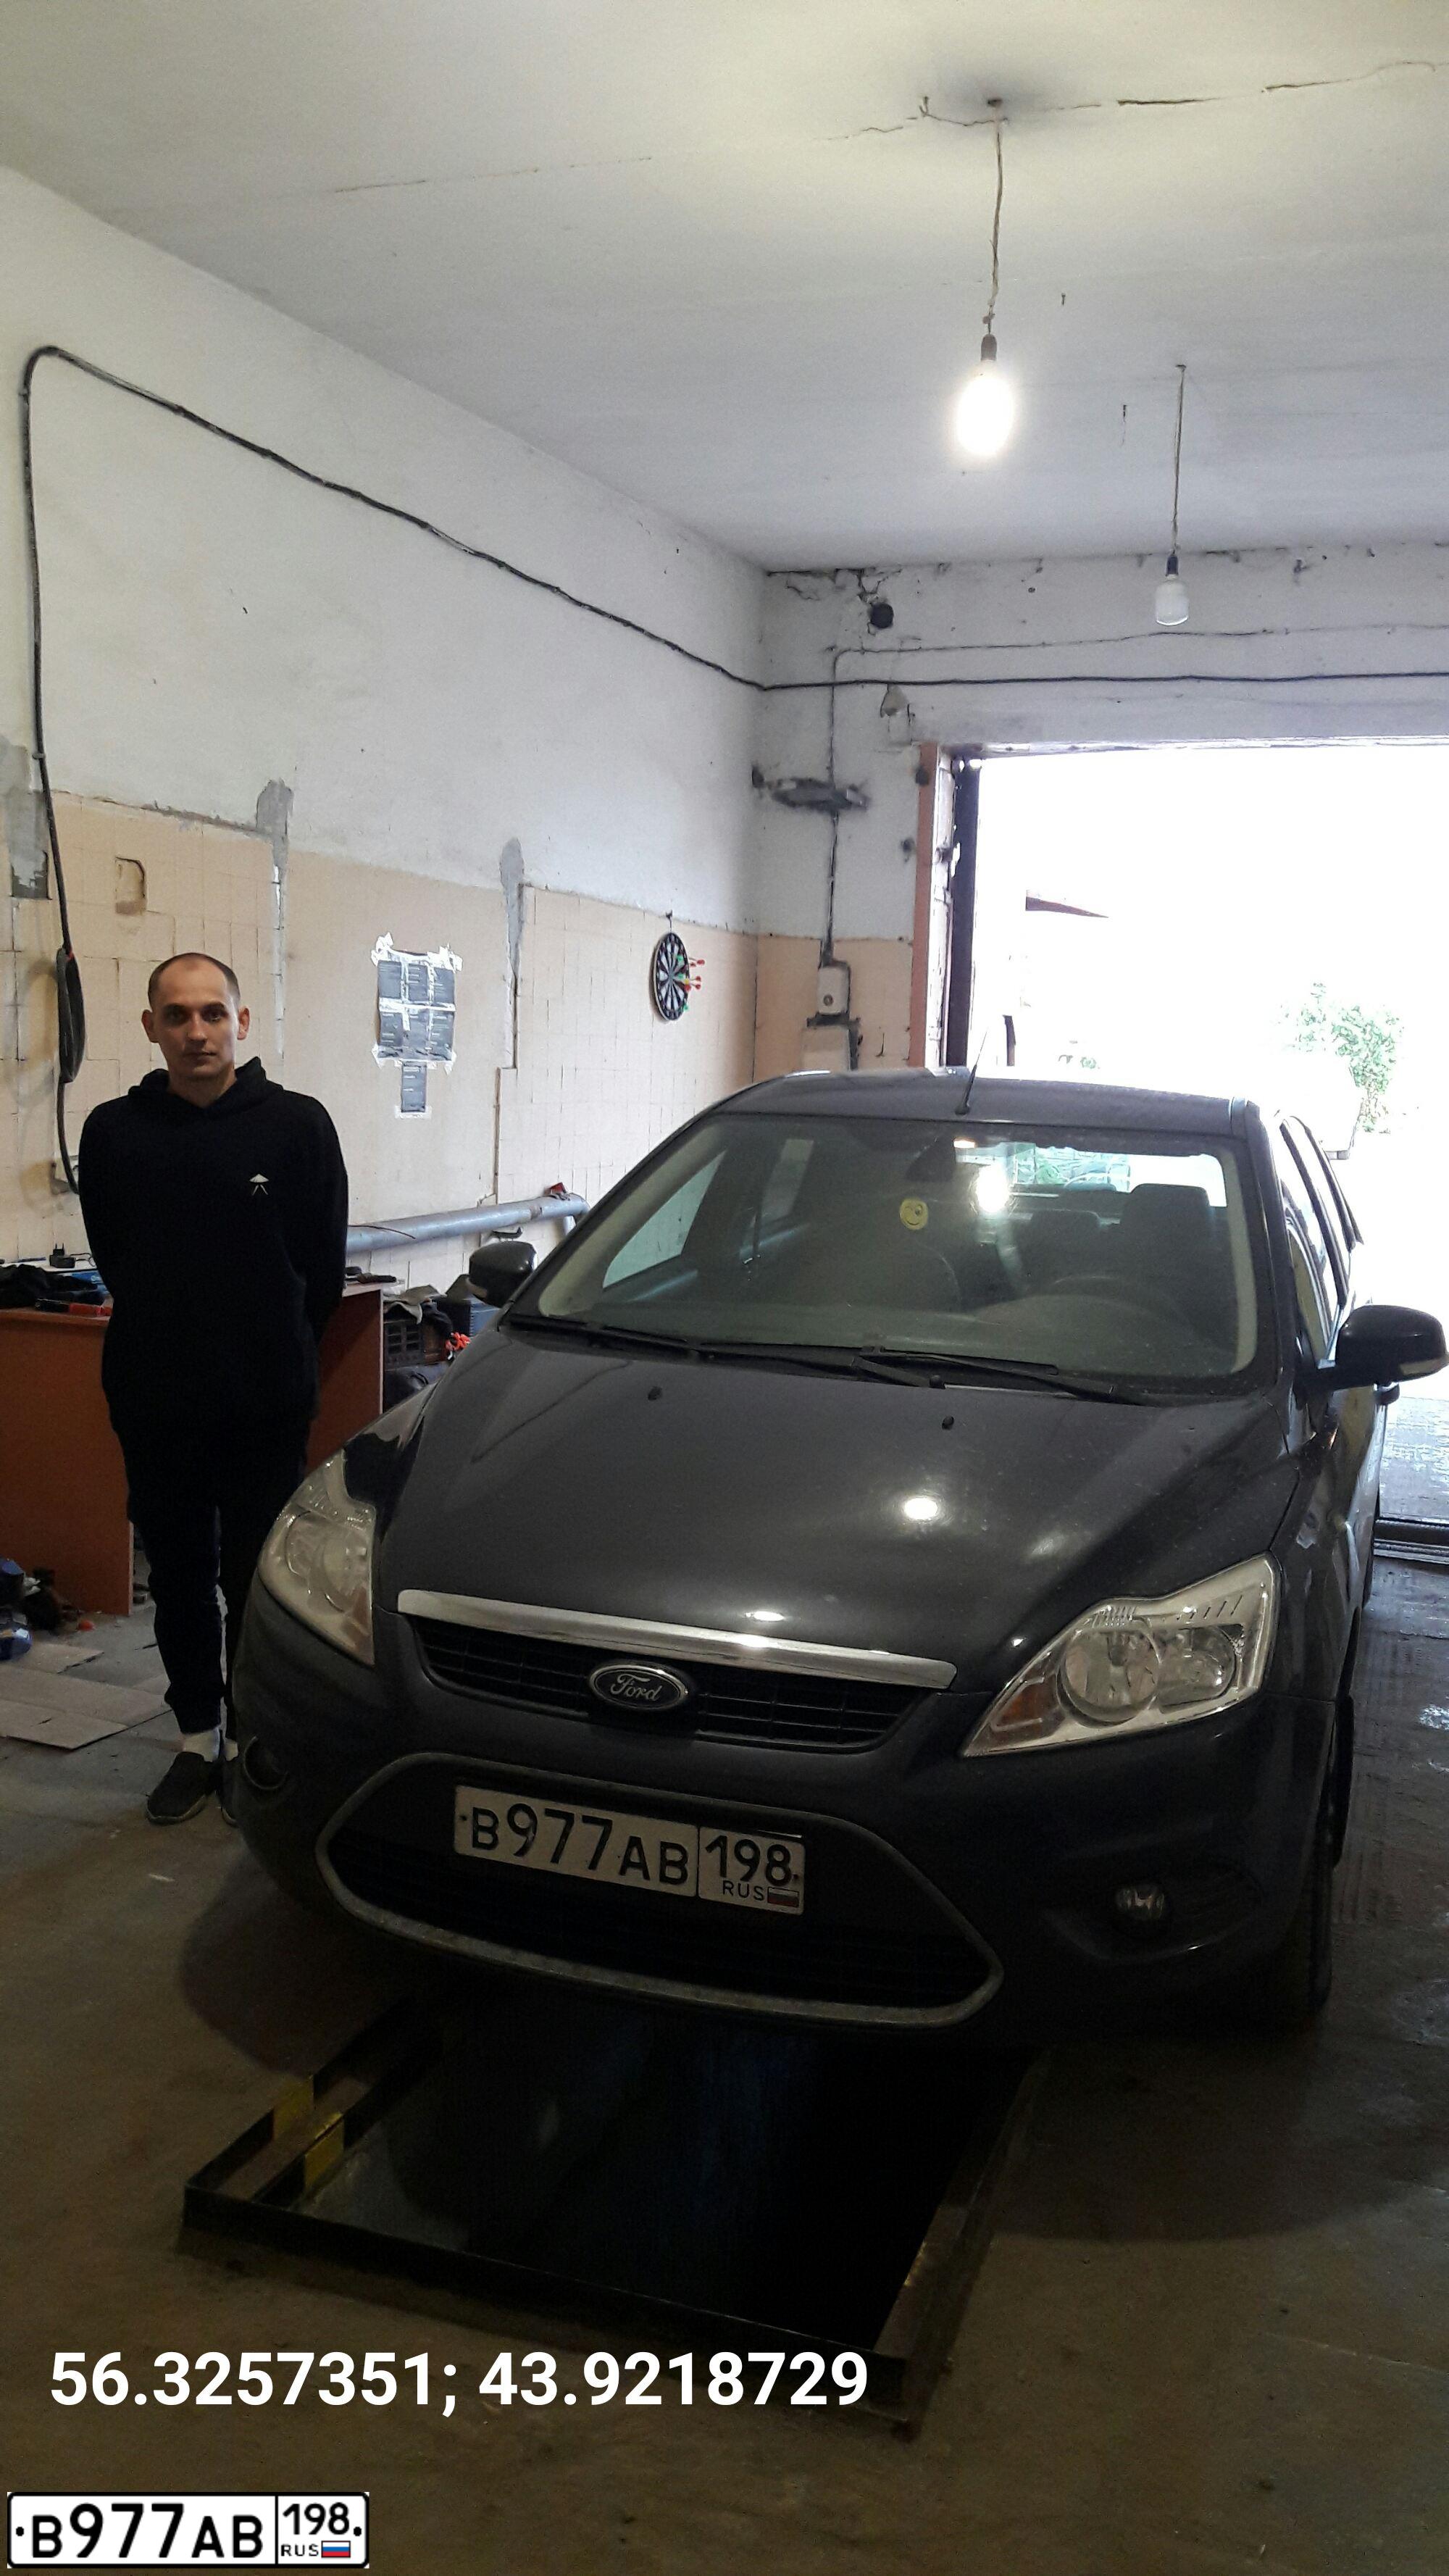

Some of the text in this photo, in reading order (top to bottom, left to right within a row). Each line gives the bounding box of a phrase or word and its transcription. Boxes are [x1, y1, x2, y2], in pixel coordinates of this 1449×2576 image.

[610, 1673, 662, 1701] Ford
[705, 1835, 792, 1886] 198
[722, 1880, 765, 1901] RUS
